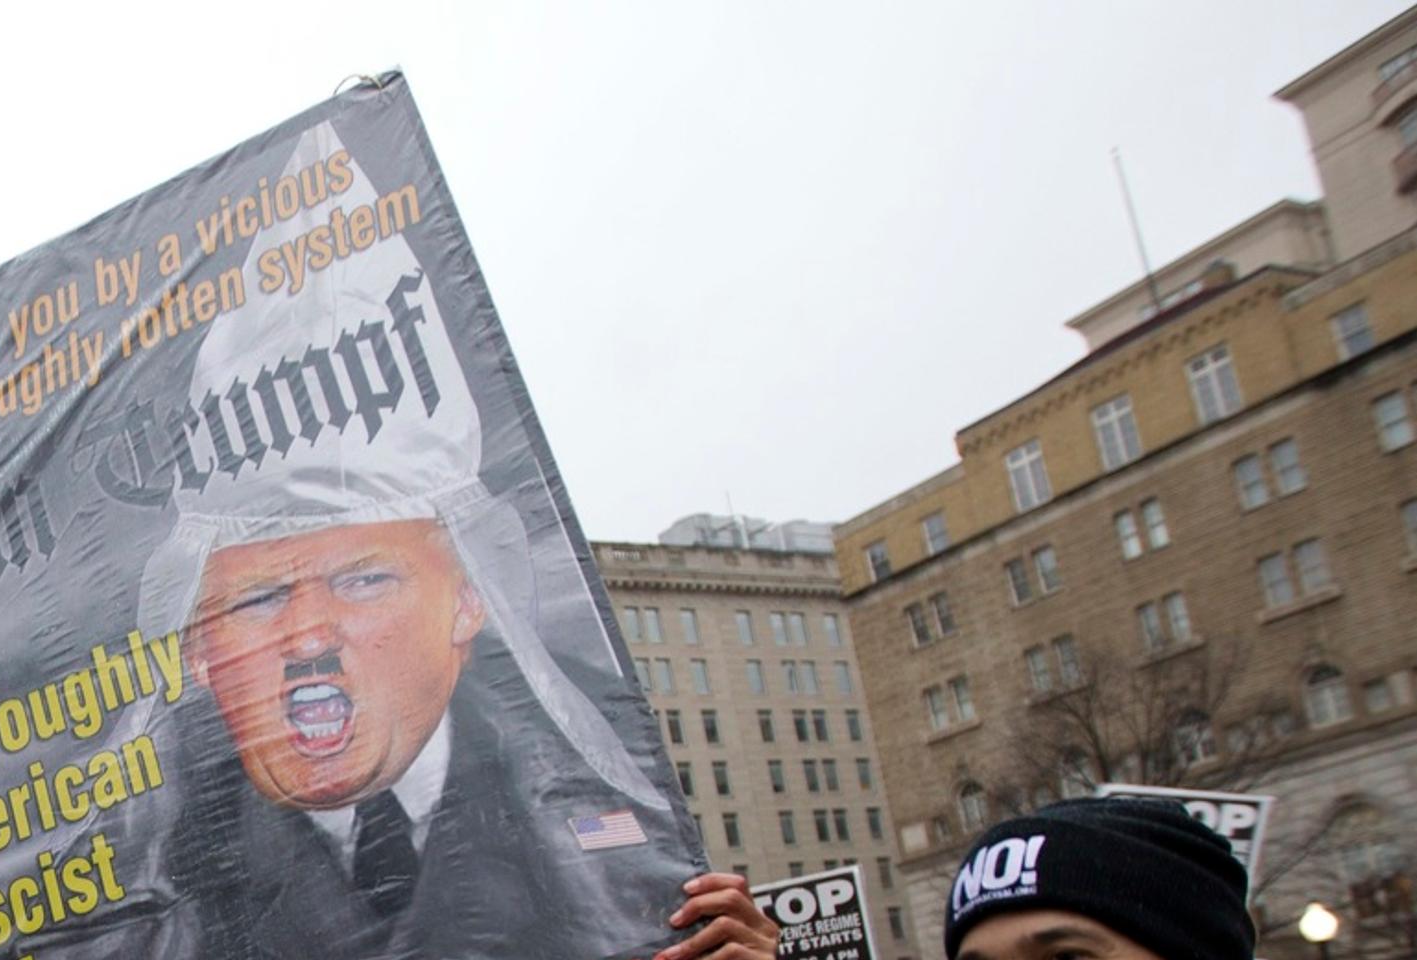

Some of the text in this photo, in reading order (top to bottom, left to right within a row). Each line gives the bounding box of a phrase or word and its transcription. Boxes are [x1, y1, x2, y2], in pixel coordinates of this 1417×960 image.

[7, 278, 82, 363] you
[93, 250, 142, 317] by
[156, 231, 182, 277] a
[196, 149, 355, 259] vicious
[119, 265, 247, 361] rotten
[259, 181, 422, 296] system
[1184, 801, 1256, 836] OP
[952, 835, 1045, 911] NO!
[816, 912, 861, 932] REGIME
[799, 929, 862, 951] STARTS
[838, 949, 858, 960] PM
